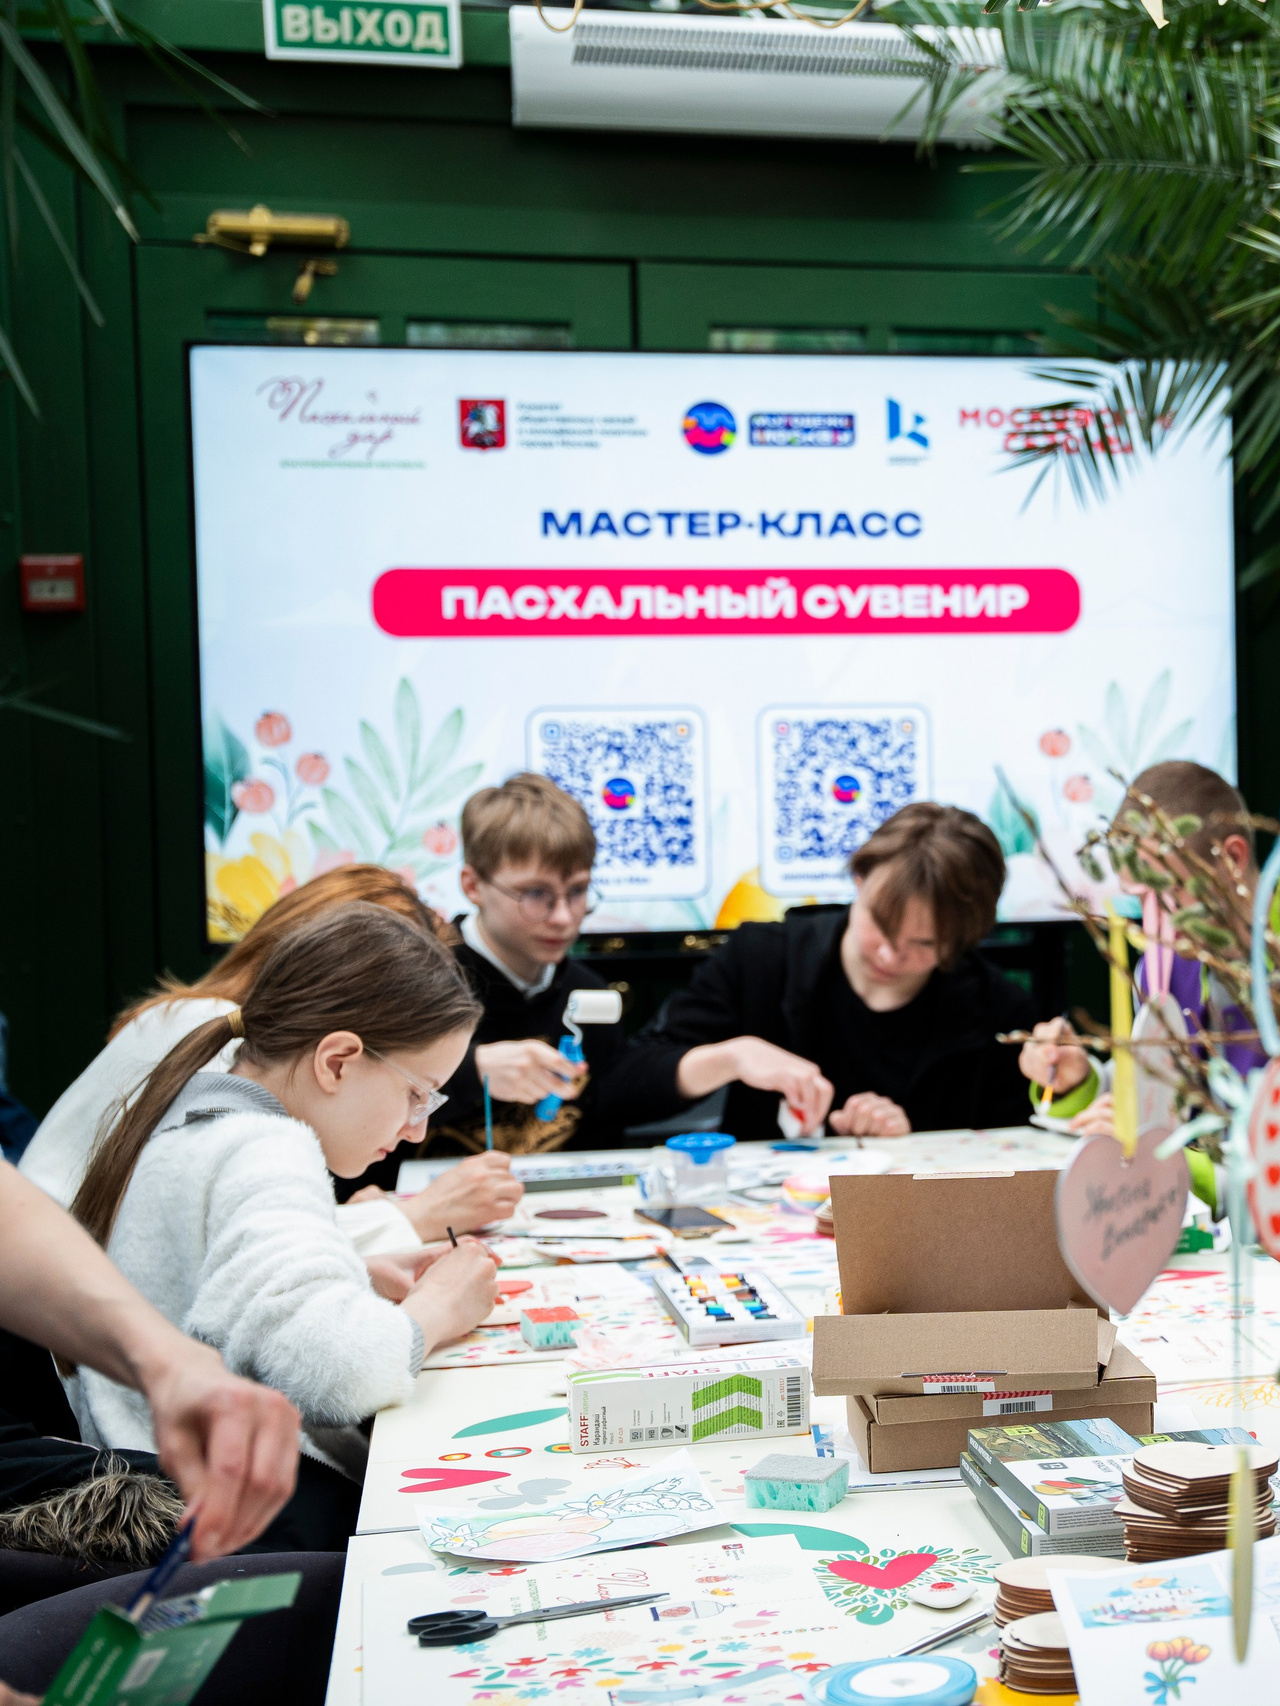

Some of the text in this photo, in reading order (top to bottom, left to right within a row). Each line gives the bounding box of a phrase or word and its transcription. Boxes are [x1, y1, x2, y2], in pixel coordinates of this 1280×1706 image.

[281, 3, 447, 53] ВЫХОД
[540, 511, 923, 538] МАСТЕР-КЛАСС
[441, 577, 1030, 619] ПАСХАЛЬНЫЙ СУВЕНИР
[580, 1416, 589, 1447] STAFF
[593, 1413, 601, 1446] Карандаш
[632, 1431, 639, 1440] 50
[648, 1429, 655, 1439] HB
